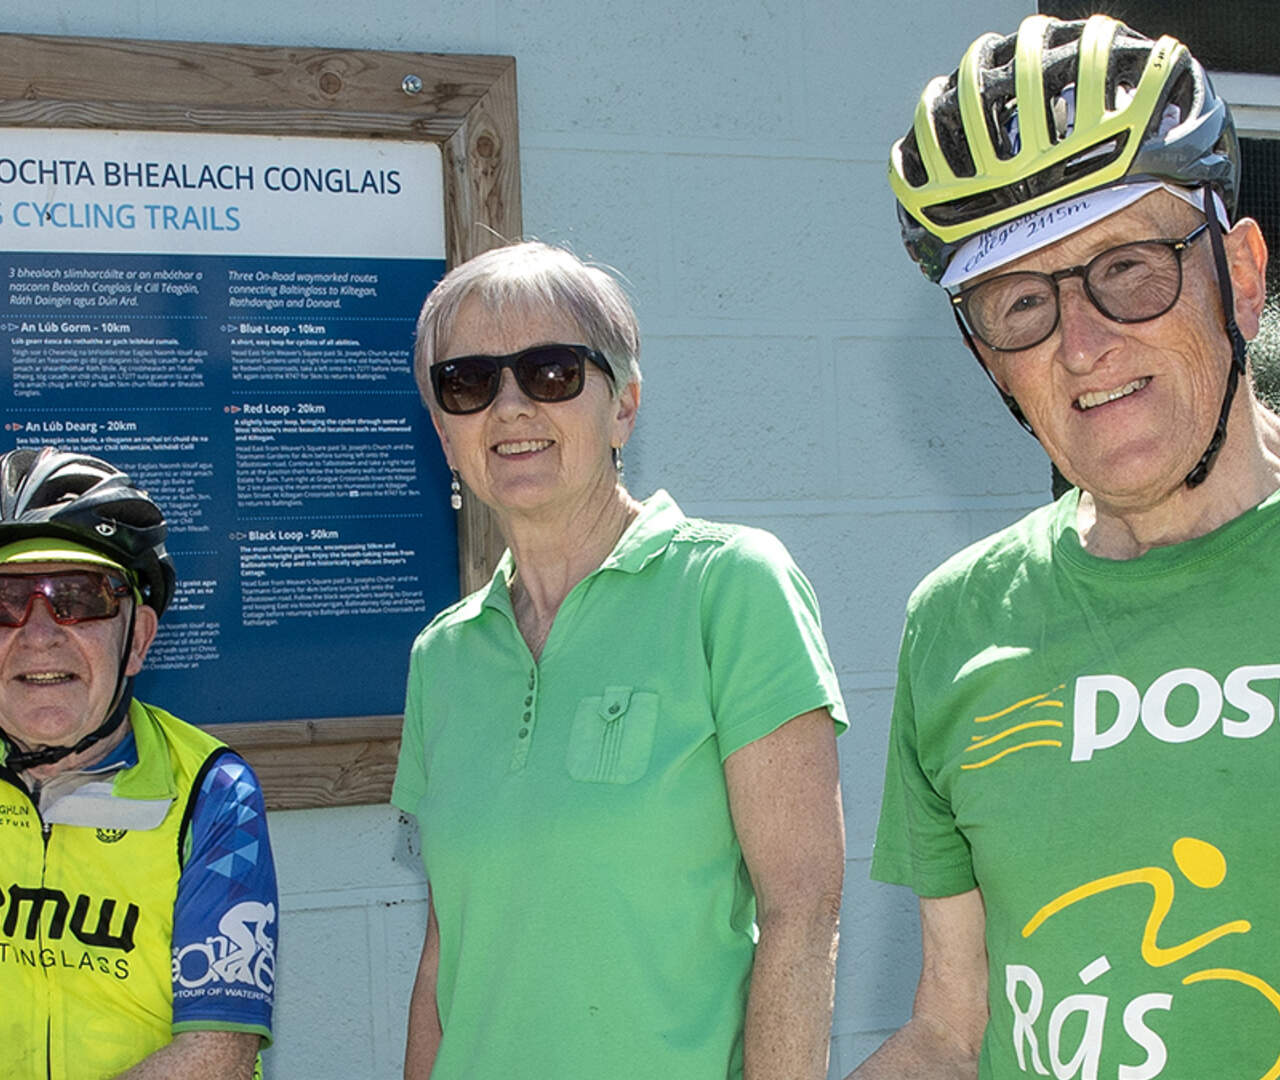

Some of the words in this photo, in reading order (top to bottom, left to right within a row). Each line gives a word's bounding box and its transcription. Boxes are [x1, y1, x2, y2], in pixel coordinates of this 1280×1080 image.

[105, 162, 253, 190] BHEALACH
[264, 167, 401, 194] CONGLAIS
[12, 202, 135, 229] CYCLING
[145, 205, 240, 231] TRAILS
[1026, 199, 1092, 238] 2115m
[8, 268, 16, 278] 3
[126, 271, 136, 280] ar
[139, 272, 151, 280] an
[228, 271, 253, 281] Three
[255, 272, 296, 282] On-Road
[296, 273, 348, 284] waymarked
[350, 274, 378, 283] routes
[9, 284, 50, 292] nascann
[52, 282, 90, 292] Bealach
[92, 282, 132, 296] Conglais
[134, 283, 142, 293] le
[144, 283, 159, 293] Cill
[228, 285, 277, 297] connecting
[279, 286, 327, 298] Baltinglass
[329, 287, 338, 296] to
[340, 287, 378, 298] Kiltegan,
[10, 296, 32, 306] Ráth
[34, 296, 71, 308] Daingin
[74, 298, 96, 308] agus
[98, 296, 118, 306] Dún
[119, 296, 138, 306] Ard.
[229, 298, 284, 310] Rathdangan
[286, 298, 304, 308] and
[306, 298, 341, 308] Donard.
[20, 322, 36, 332] An
[38, 321, 58, 332] Lúb
[60, 323, 90, 333] Gorm
[102, 322, 130, 333] 10km
[240, 324, 262, 334] Blue
[266, 325, 290, 336] Loop
[298, 325, 326, 334] 10km
[244, 404, 262, 414] Red
[266, 405, 290, 416] Loop
[298, 404, 326, 414] 20km
[26, 422, 40, 432] An
[43, 420, 62, 432] Lúb
[66, 422, 98, 433] Dearg
[107, 421, 137, 432] 20km
[248, 530, 276, 540] Black
[279, 530, 303, 542] Loop
[311, 529, 338, 540] 50km
[178, 988, 205, 998] TOUR
[207, 988, 222, 996] OF
